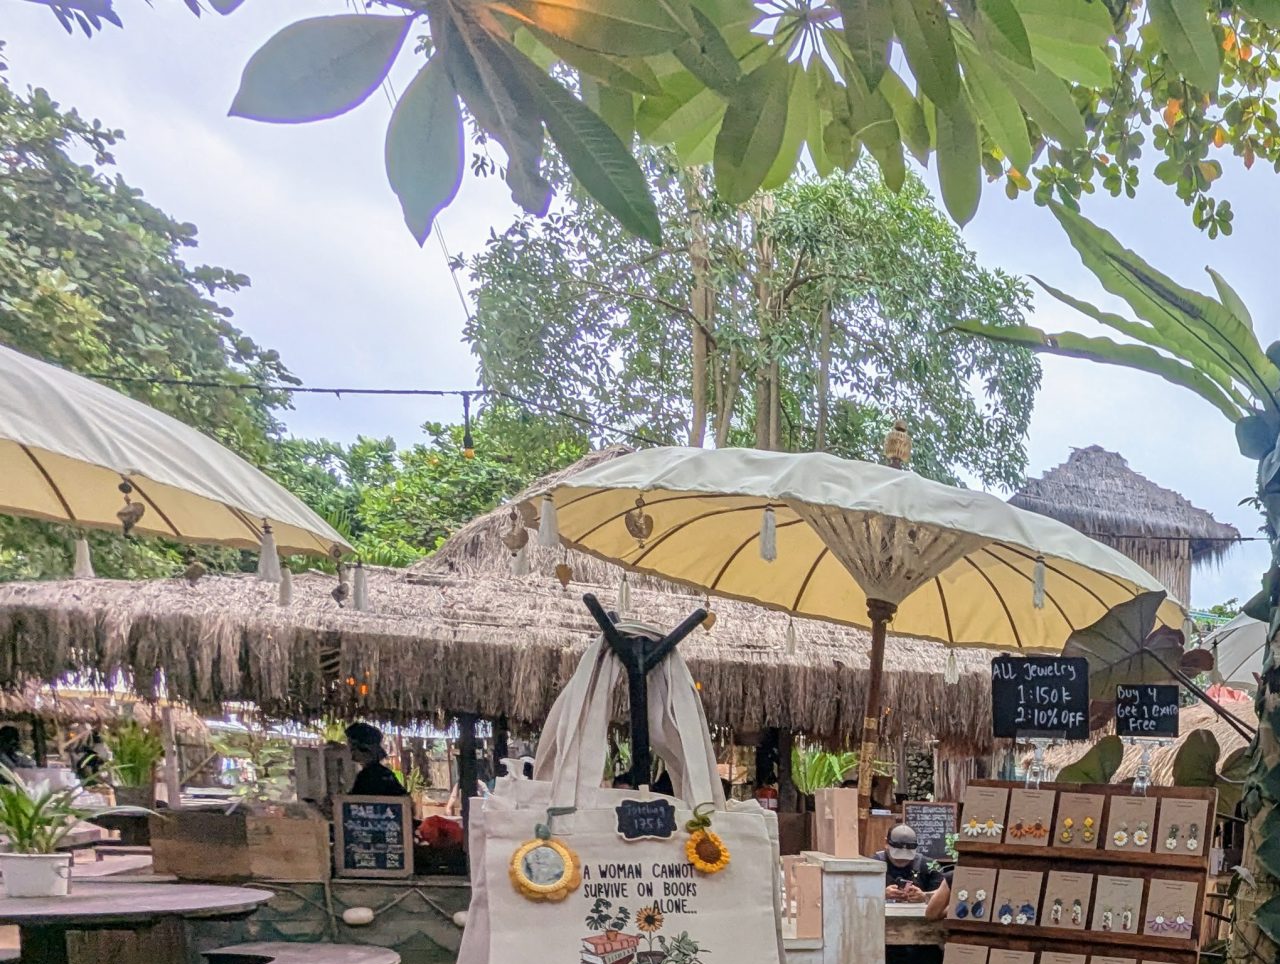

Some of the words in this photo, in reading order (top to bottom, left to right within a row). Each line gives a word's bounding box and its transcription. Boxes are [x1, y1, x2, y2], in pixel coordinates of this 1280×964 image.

[1117, 686, 1139, 704] Buy
[1148, 688, 1157, 702] 4
[1061, 710, 1085, 727] OFF
[1117, 705, 1138, 717] Get
[1129, 718, 1157, 731] Free
[584, 864, 590, 879] A
[599, 863, 642, 879] WOMAN
[652, 863, 695, 879] CANNOT
[584, 883, 629, 898] SURVIVE
[637, 883, 653, 897] ON
[664, 882, 697, 897] BOOKS
